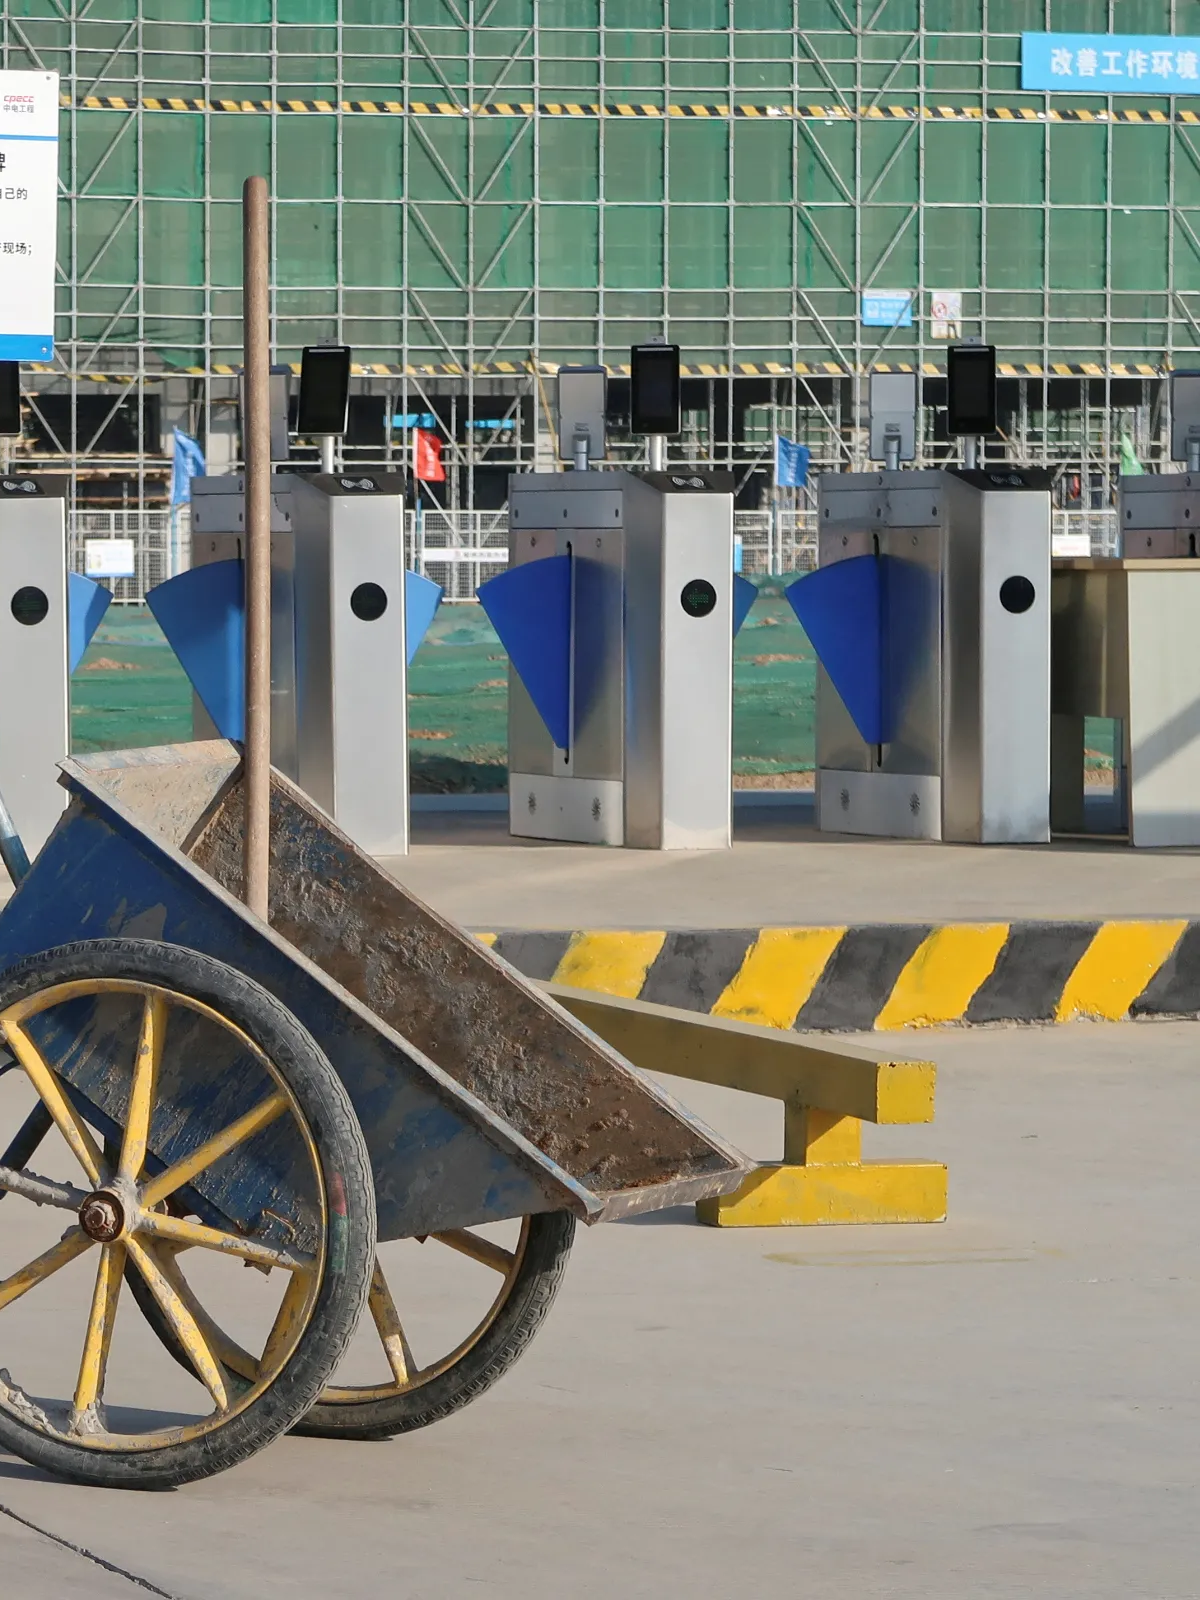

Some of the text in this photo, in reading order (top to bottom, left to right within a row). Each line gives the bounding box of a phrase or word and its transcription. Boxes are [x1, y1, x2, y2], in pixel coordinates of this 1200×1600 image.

[1050, 47, 1199, 79] 改善工作环境
[3, 104, 34, 113] 中电工程
